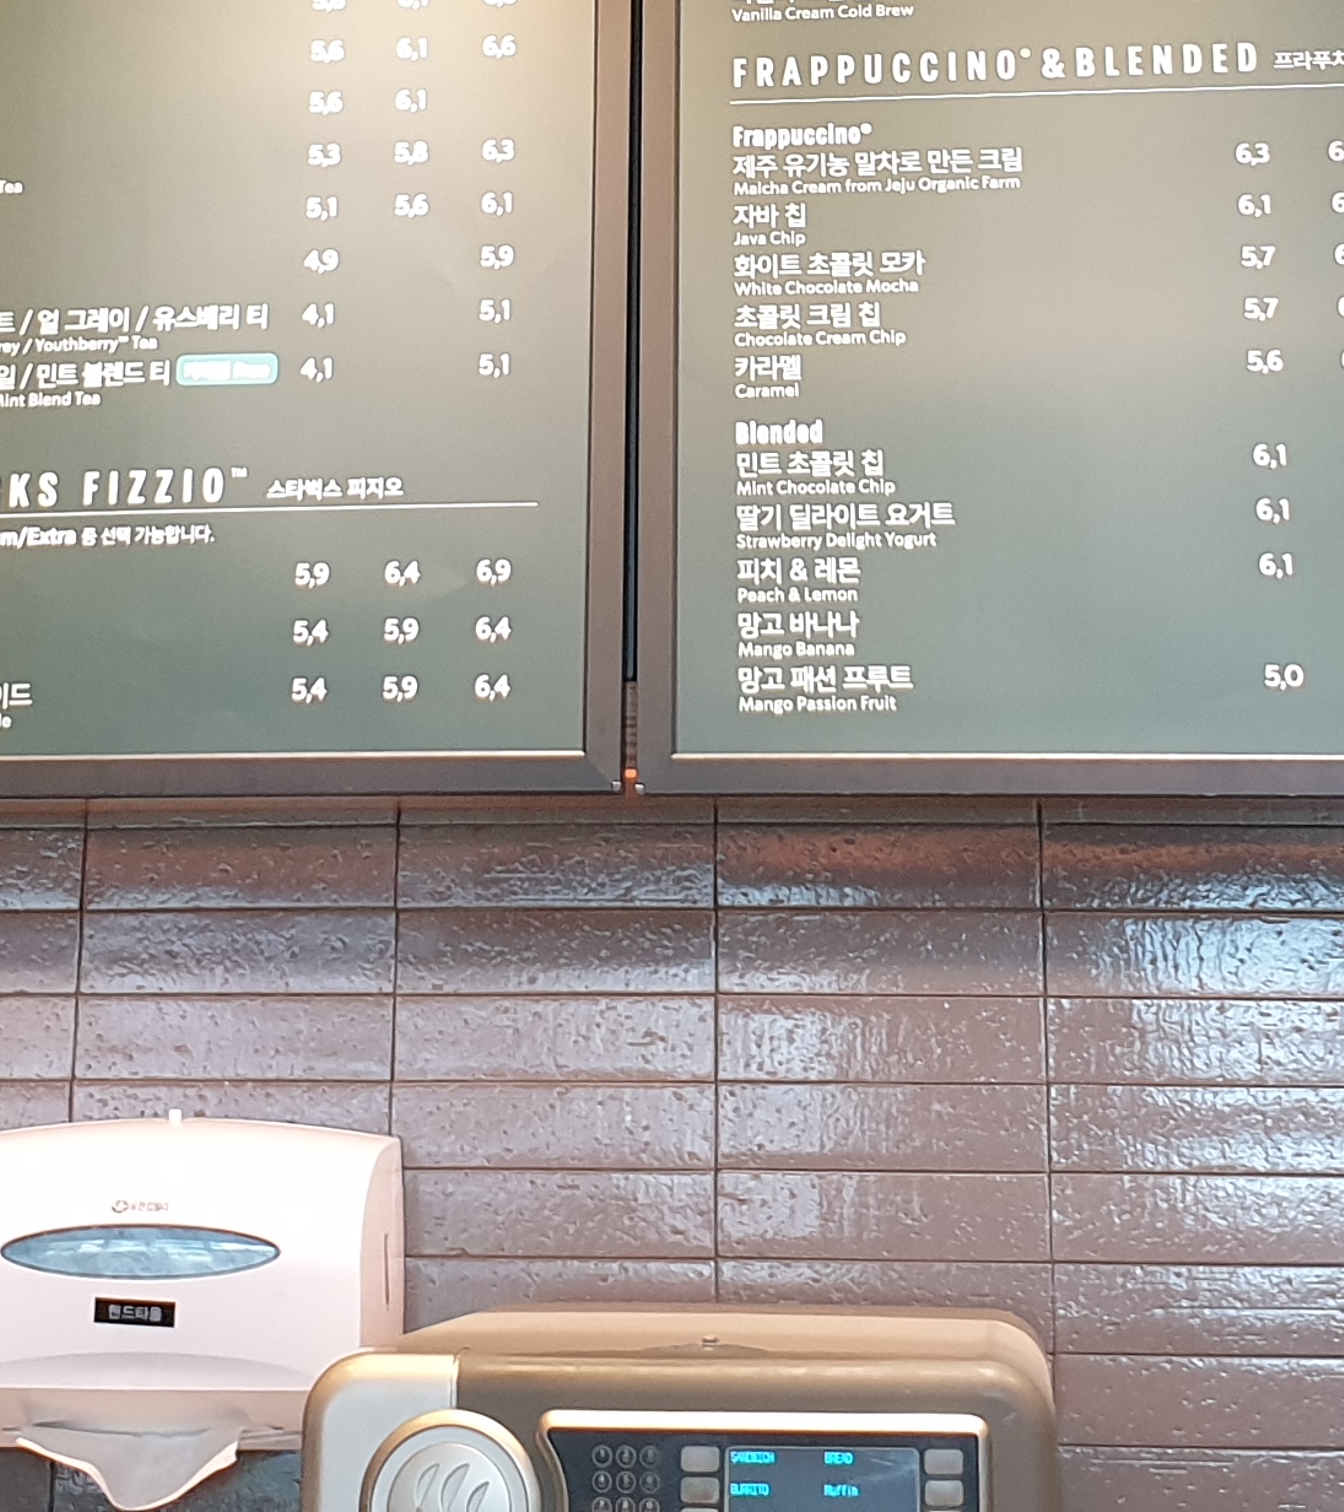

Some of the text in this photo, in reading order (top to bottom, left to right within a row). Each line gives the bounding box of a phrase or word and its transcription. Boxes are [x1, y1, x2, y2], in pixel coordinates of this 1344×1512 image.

[731, 3, 915, 22] Vanilla Cream Cold Brew
[732, 146, 1023, 179] 제주 유기농 말차로 만든 크림
[1235, 143, 1270, 167] 6,3
[791, 180, 842, 195] Cream
[844, 178, 882, 193] from
[884, 177, 916, 195] Jeju
[918, 175, 980, 194] Organic
[981, 174, 1021, 189] Farm
[303, 245, 514, 274] 4,9 5,9
[736, 501, 956, 532] 딸기 딜라이트 요거트
[736, 531, 937, 552] Strawberry Delight Yogurt
[294, 559, 511, 589] 5,9 6,4 6,9
[737, 610, 860, 640] 망고 바나나
[738, 641, 855, 660] Mango Banana
